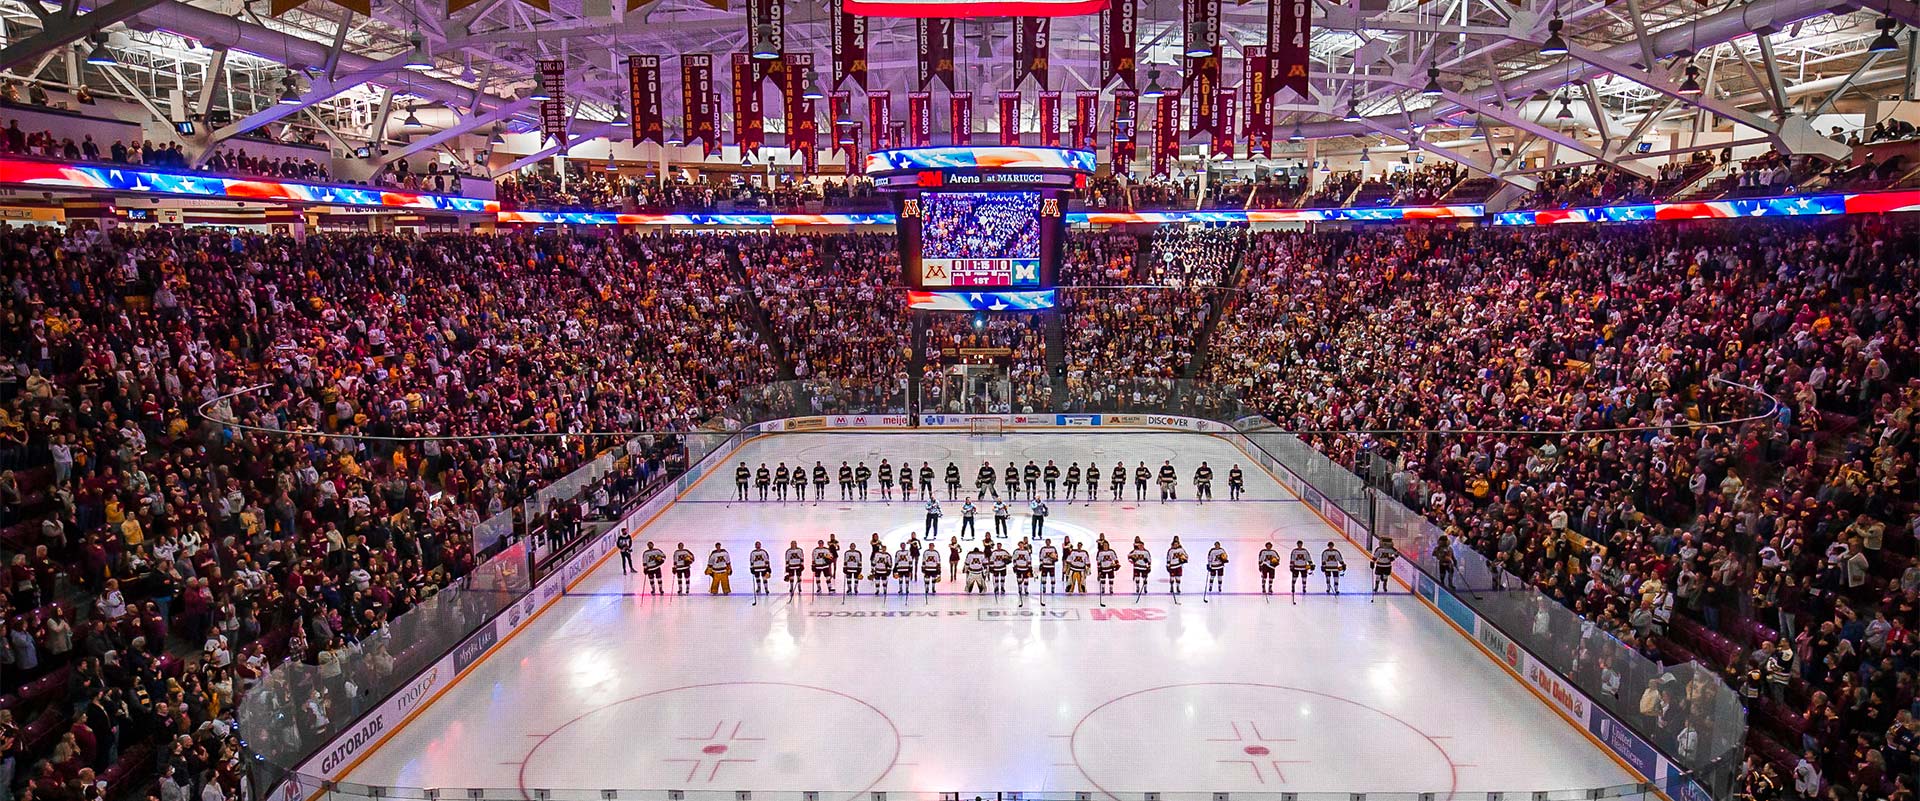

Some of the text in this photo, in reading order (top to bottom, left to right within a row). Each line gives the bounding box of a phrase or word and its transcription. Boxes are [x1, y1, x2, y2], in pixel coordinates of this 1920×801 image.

[941, 19, 950, 48] 71
[1036, 18, 1046, 48] 75
[1123, 0, 1132, 48] 981
[1207, 0, 1217, 47] 989
[1293, 0, 1304, 47] 014
[753, 63, 760, 82] UP
[835, 62, 842, 80] UP
[921, 62, 928, 80] UP
[1016, 61, 1022, 79] UP
[1103, 61, 1110, 79] UP
[1187, 59, 1193, 77] UP
[1271, 60, 1279, 78] UP
[633, 69, 641, 137] CHAMPIONS
[648, 71, 657, 115] 2014
[700, 69, 708, 114] 2015
[1254, 72, 1262, 114] 2021
[1225, 99, 1233, 134] 2012
[917, 171, 943, 187] 3M
[950, 174, 980, 183] Arena
[998, 174, 1043, 182] MARIUCCI
[1149, 416, 1188, 427] DISCOVER
[321, 714, 384, 775] GATORADE
[1612, 724, 1632, 747] United
[1611, 735, 1643, 769] Healthcare
